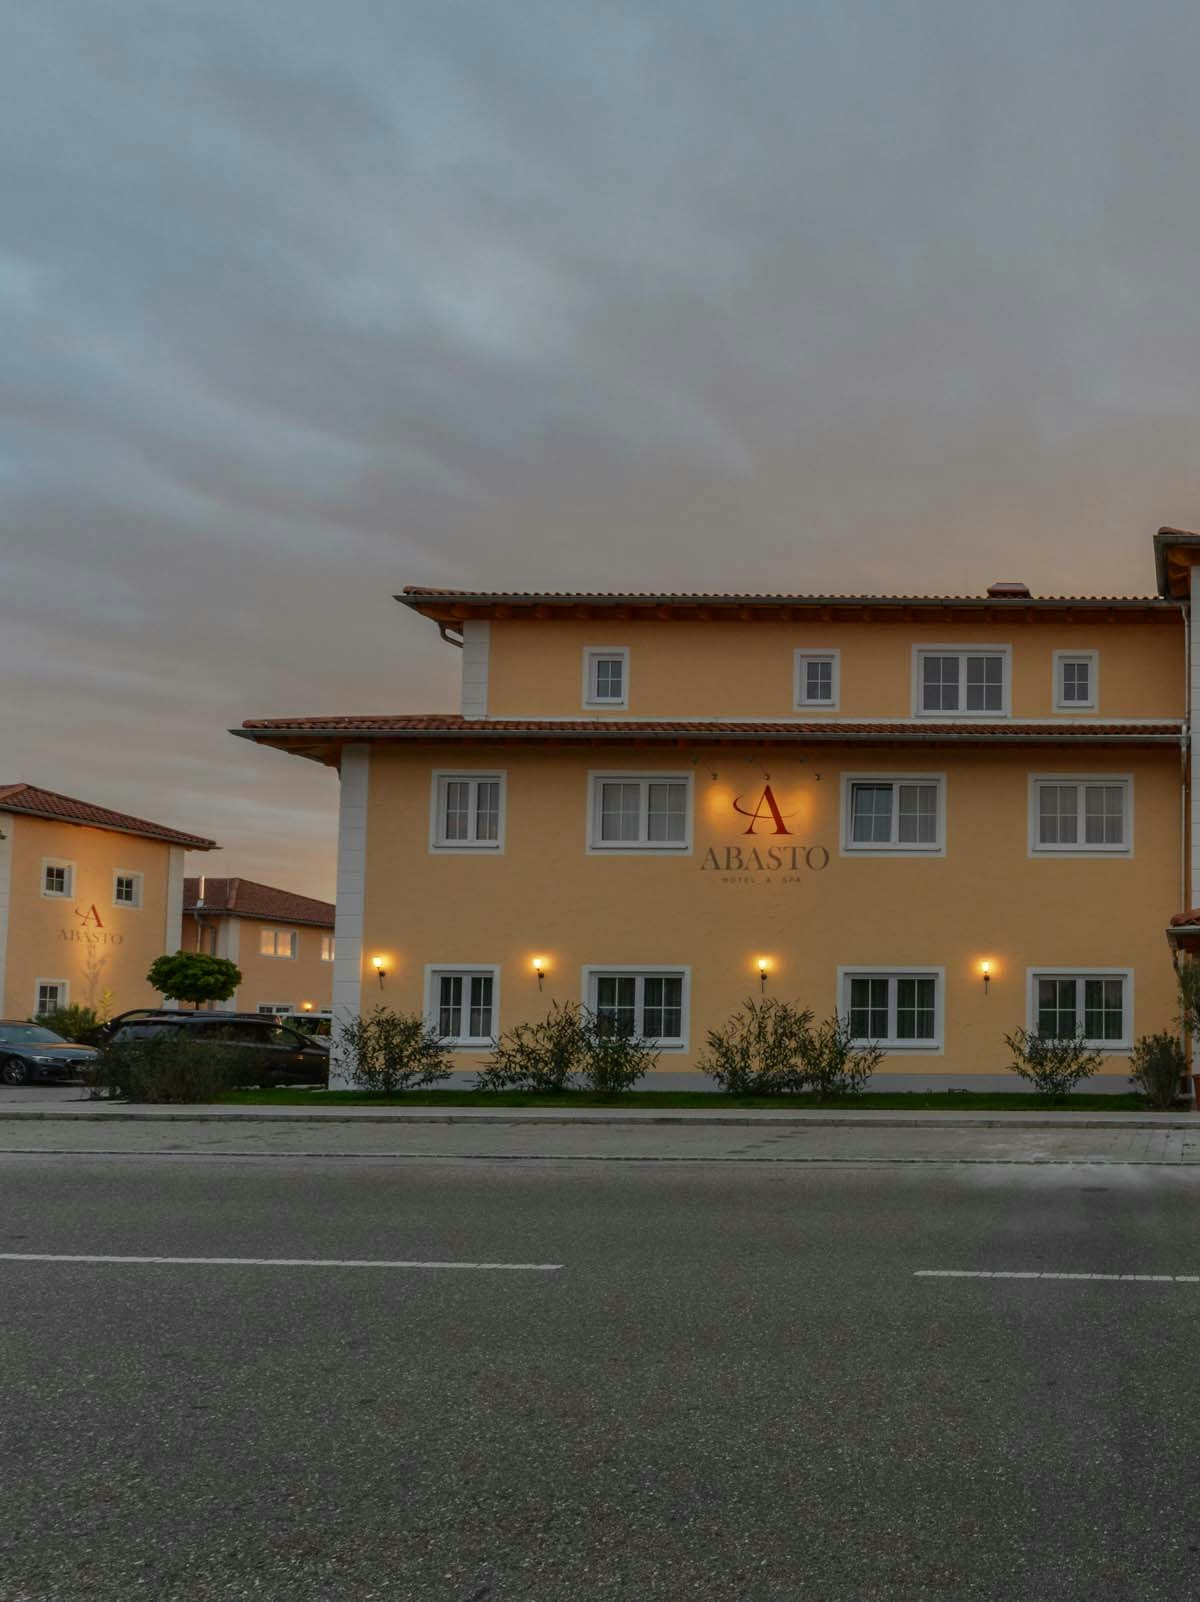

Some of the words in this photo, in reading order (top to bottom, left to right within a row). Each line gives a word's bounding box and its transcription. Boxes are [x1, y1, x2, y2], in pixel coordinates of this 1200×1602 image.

[733, 783, 800, 835] A
[701, 846, 830, 871] ABASTO
[74, 903, 105, 928] A
[57, 928, 124, 945] ABASTO
